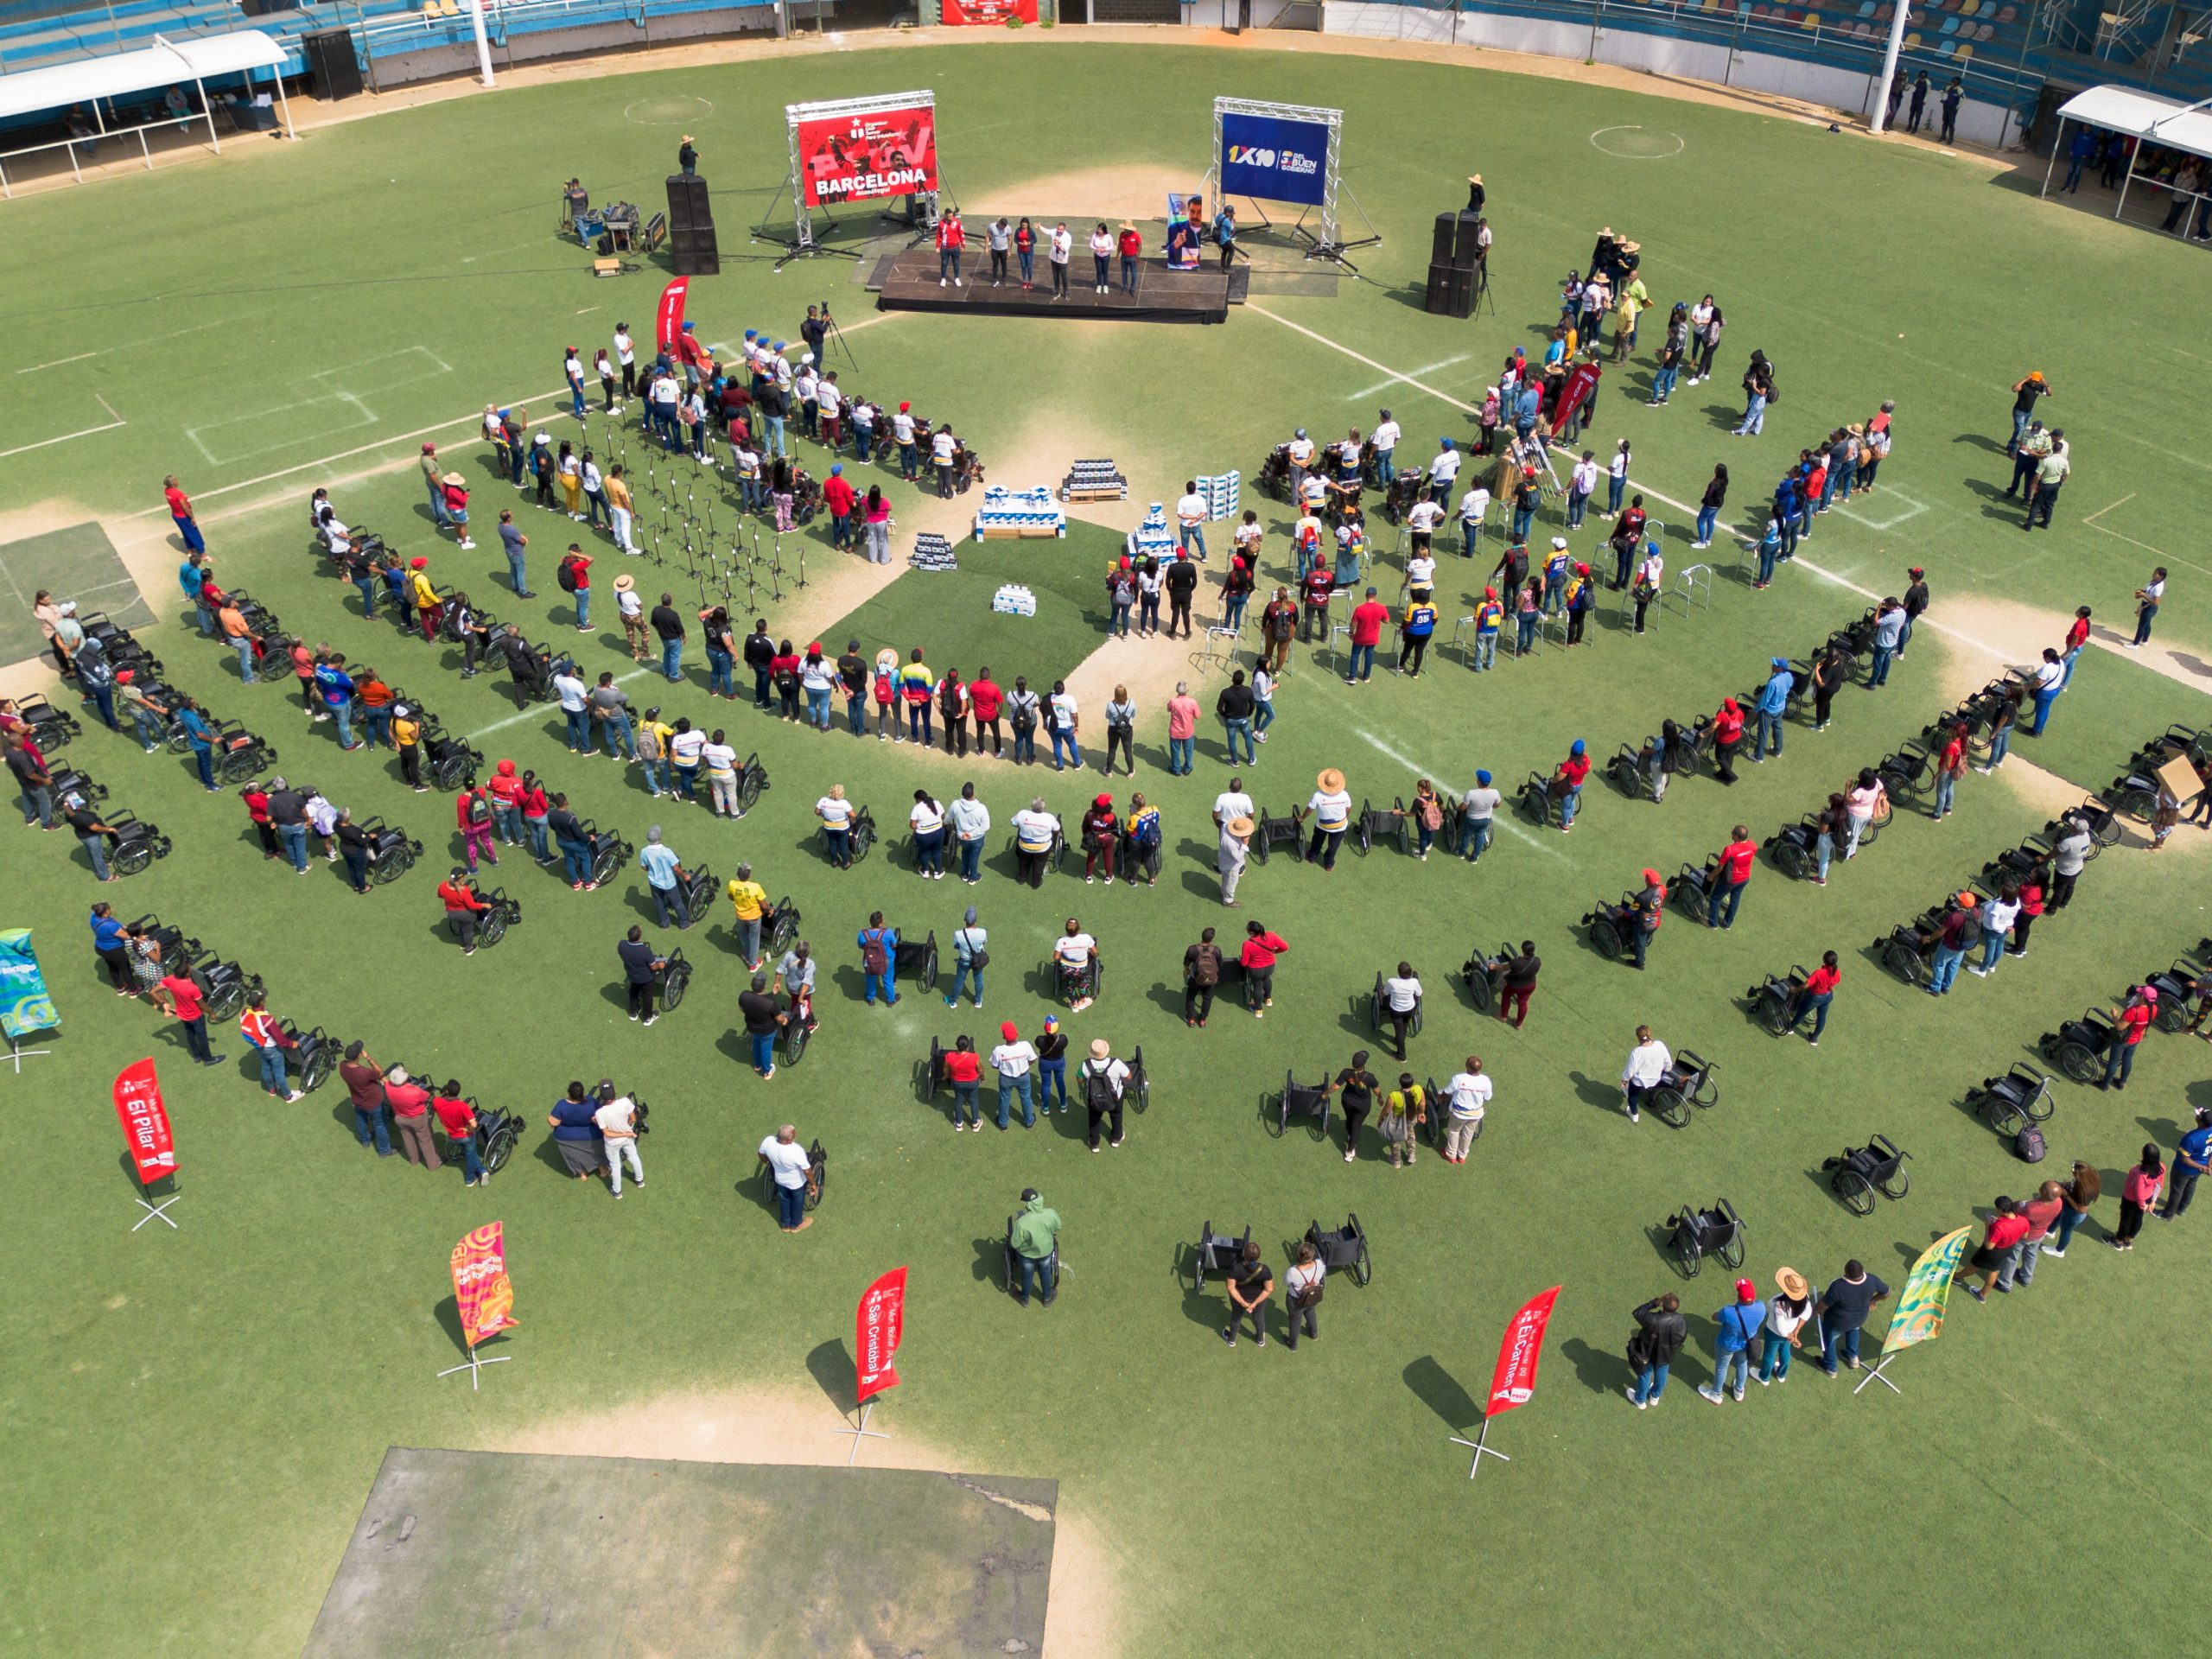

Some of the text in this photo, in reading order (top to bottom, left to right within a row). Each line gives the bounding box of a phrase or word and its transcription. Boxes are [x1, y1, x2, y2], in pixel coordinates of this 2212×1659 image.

[1229, 145, 1275, 168] 1X10
[1291, 158, 1318, 169] BUEN
[1281, 164, 1316, 175] GOBIERNO
[816, 168, 927, 195] BARCELONA
[127, 1100, 147, 1116] El
[133, 1116, 156, 1149] Pilar
[868, 1305, 880, 1325] San
[1503, 1325, 1533, 1388] El Carmen
